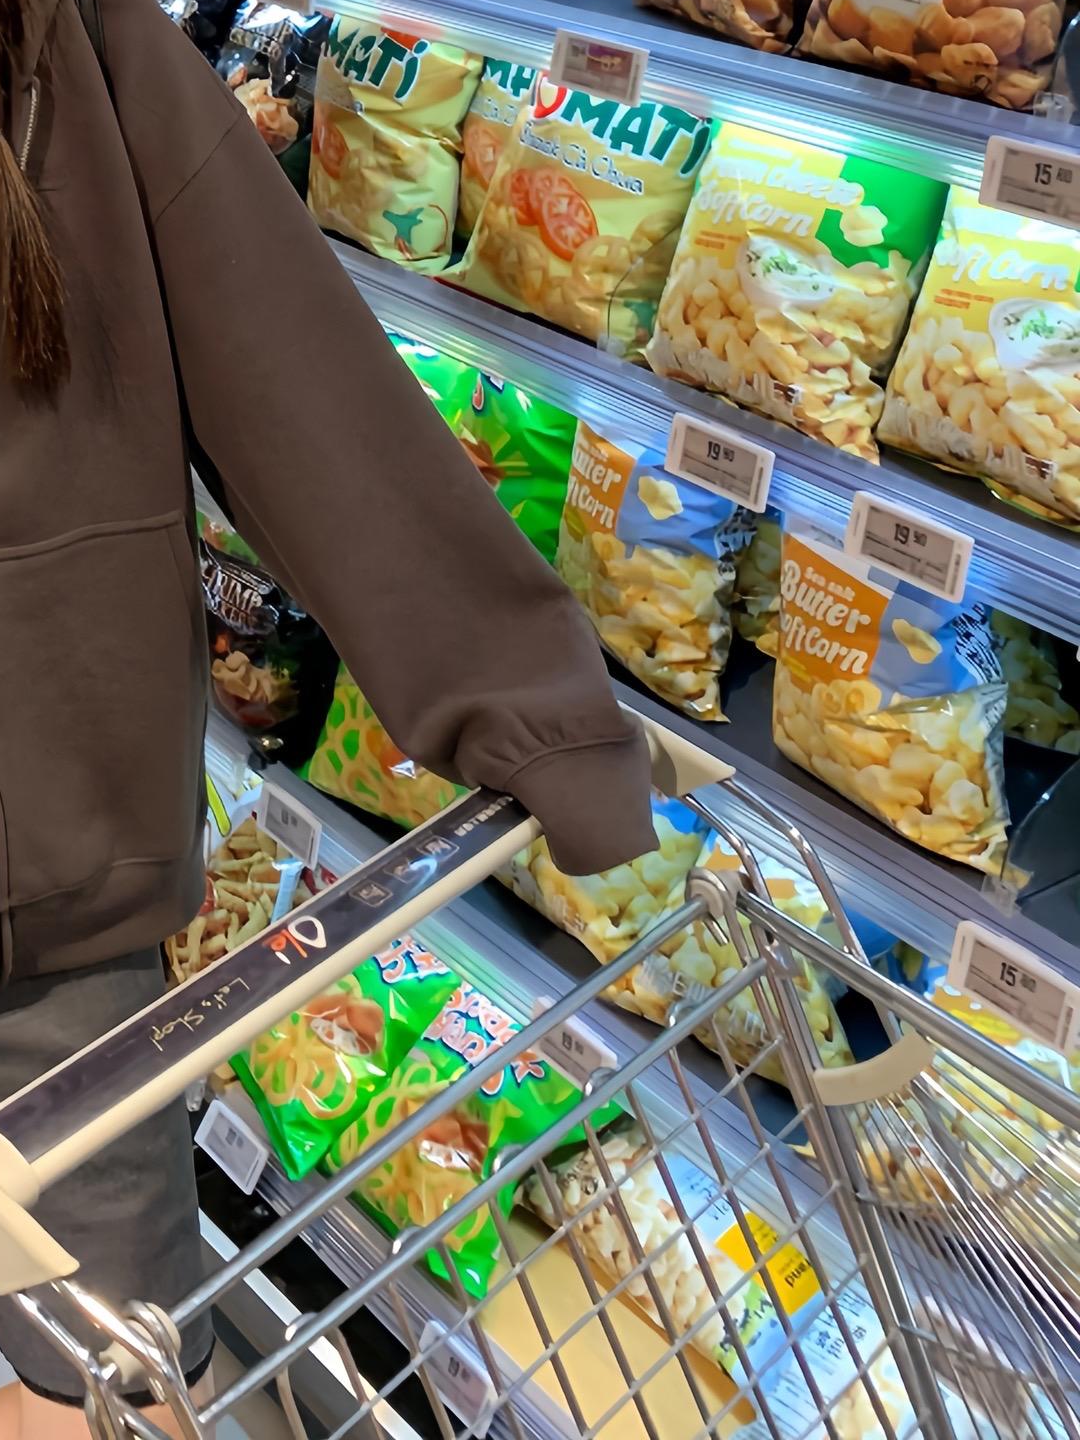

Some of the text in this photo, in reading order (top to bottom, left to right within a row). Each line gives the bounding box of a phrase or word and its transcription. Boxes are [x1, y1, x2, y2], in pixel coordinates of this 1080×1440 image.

[1033, 162, 1053, 186] 15
[706, 440, 721, 461] 19
[894, 522, 910, 545] 19
[780, 559, 872, 634] Butter
[999, 961, 1019, 988] 15
